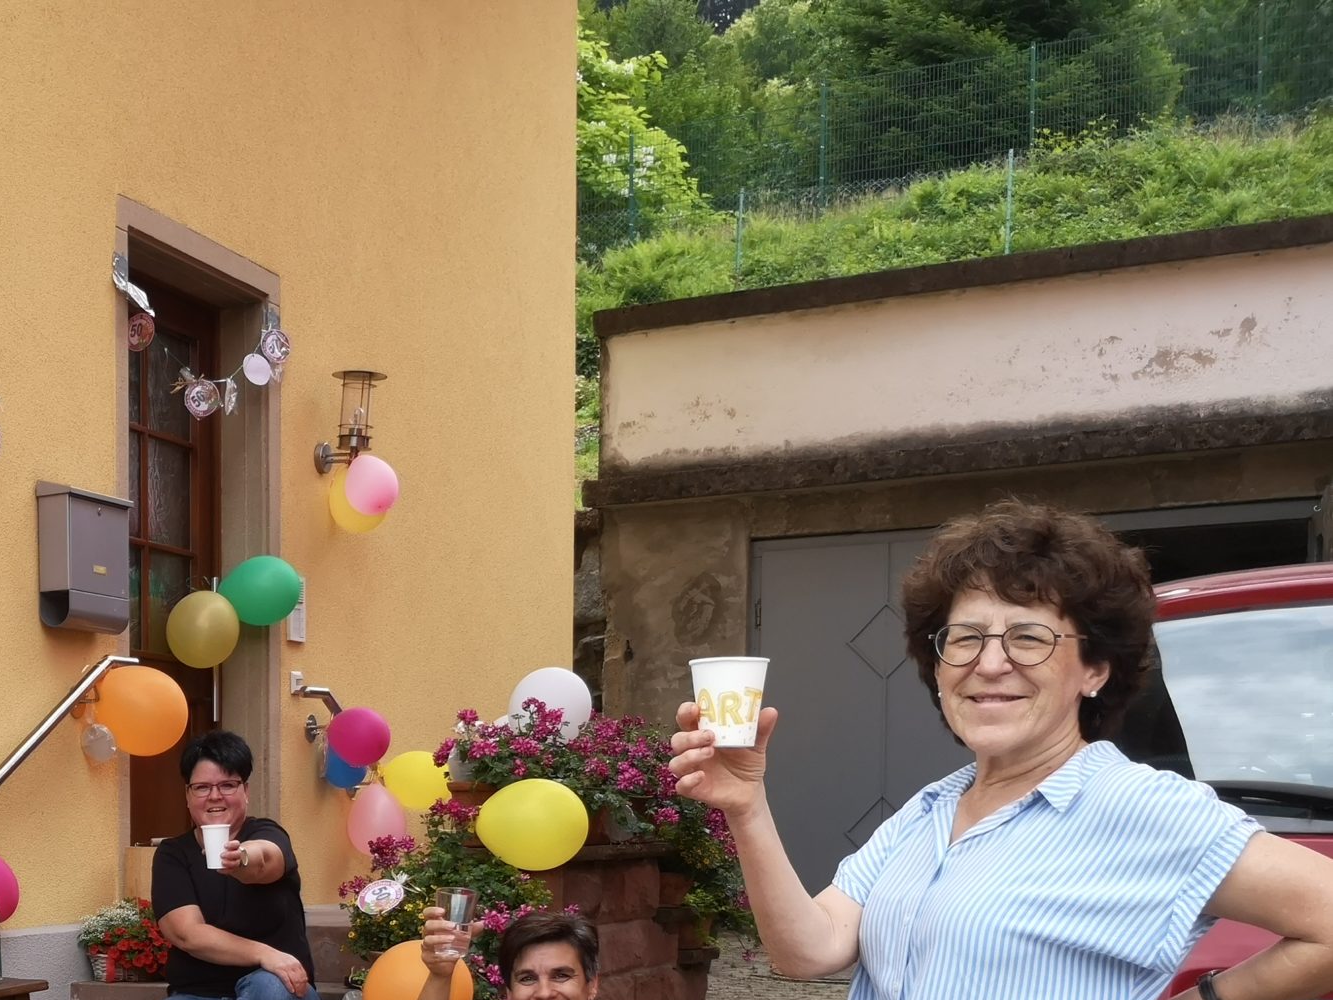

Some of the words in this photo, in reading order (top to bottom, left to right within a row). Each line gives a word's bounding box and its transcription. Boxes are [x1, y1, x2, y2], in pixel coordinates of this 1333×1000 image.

[129, 323, 143, 338] 50
[191, 390, 205, 408] 50
[371, 886, 392, 901] 50
